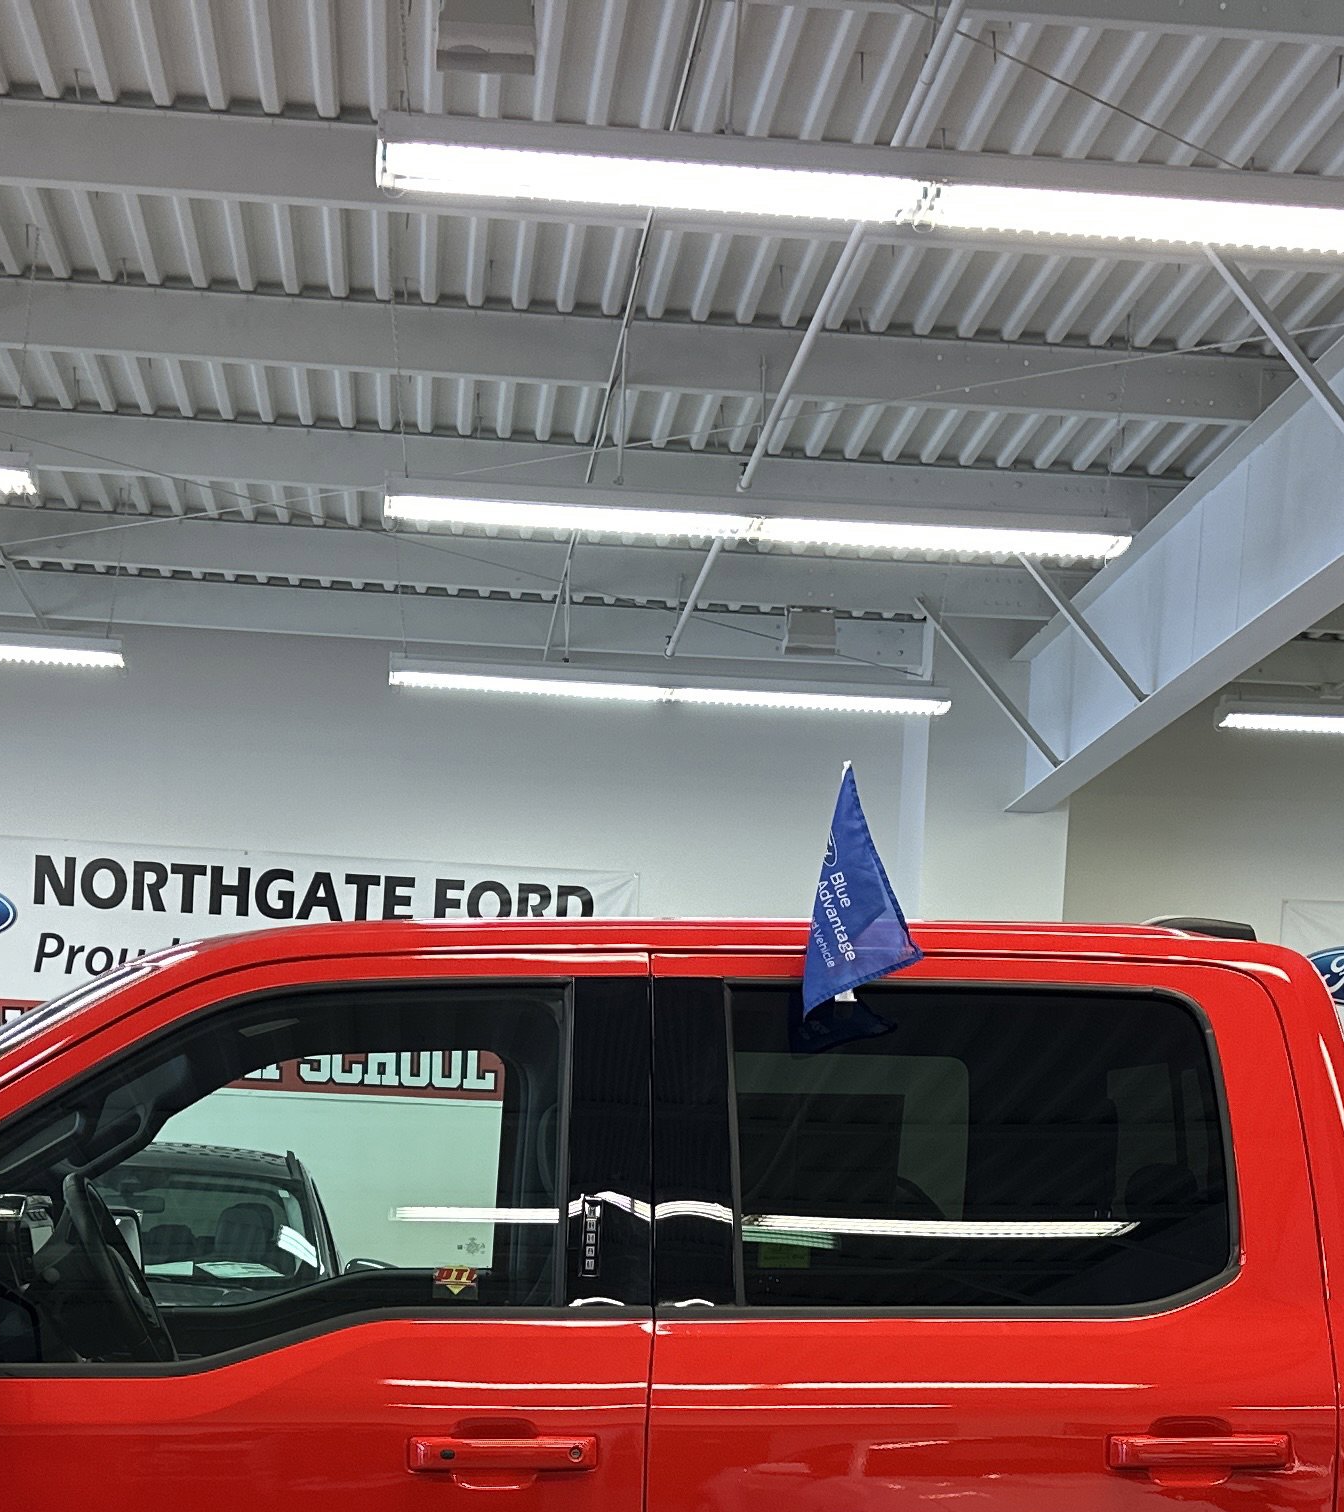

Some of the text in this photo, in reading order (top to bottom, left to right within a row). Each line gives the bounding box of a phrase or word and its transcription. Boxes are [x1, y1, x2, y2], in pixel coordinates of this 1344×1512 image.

[33, 854, 594, 921] NORTHGATE FORD
[830, 872, 851, 908] Blue
[818, 880, 856, 962] Advantage
[813, 928, 836, 968] Vehicle
